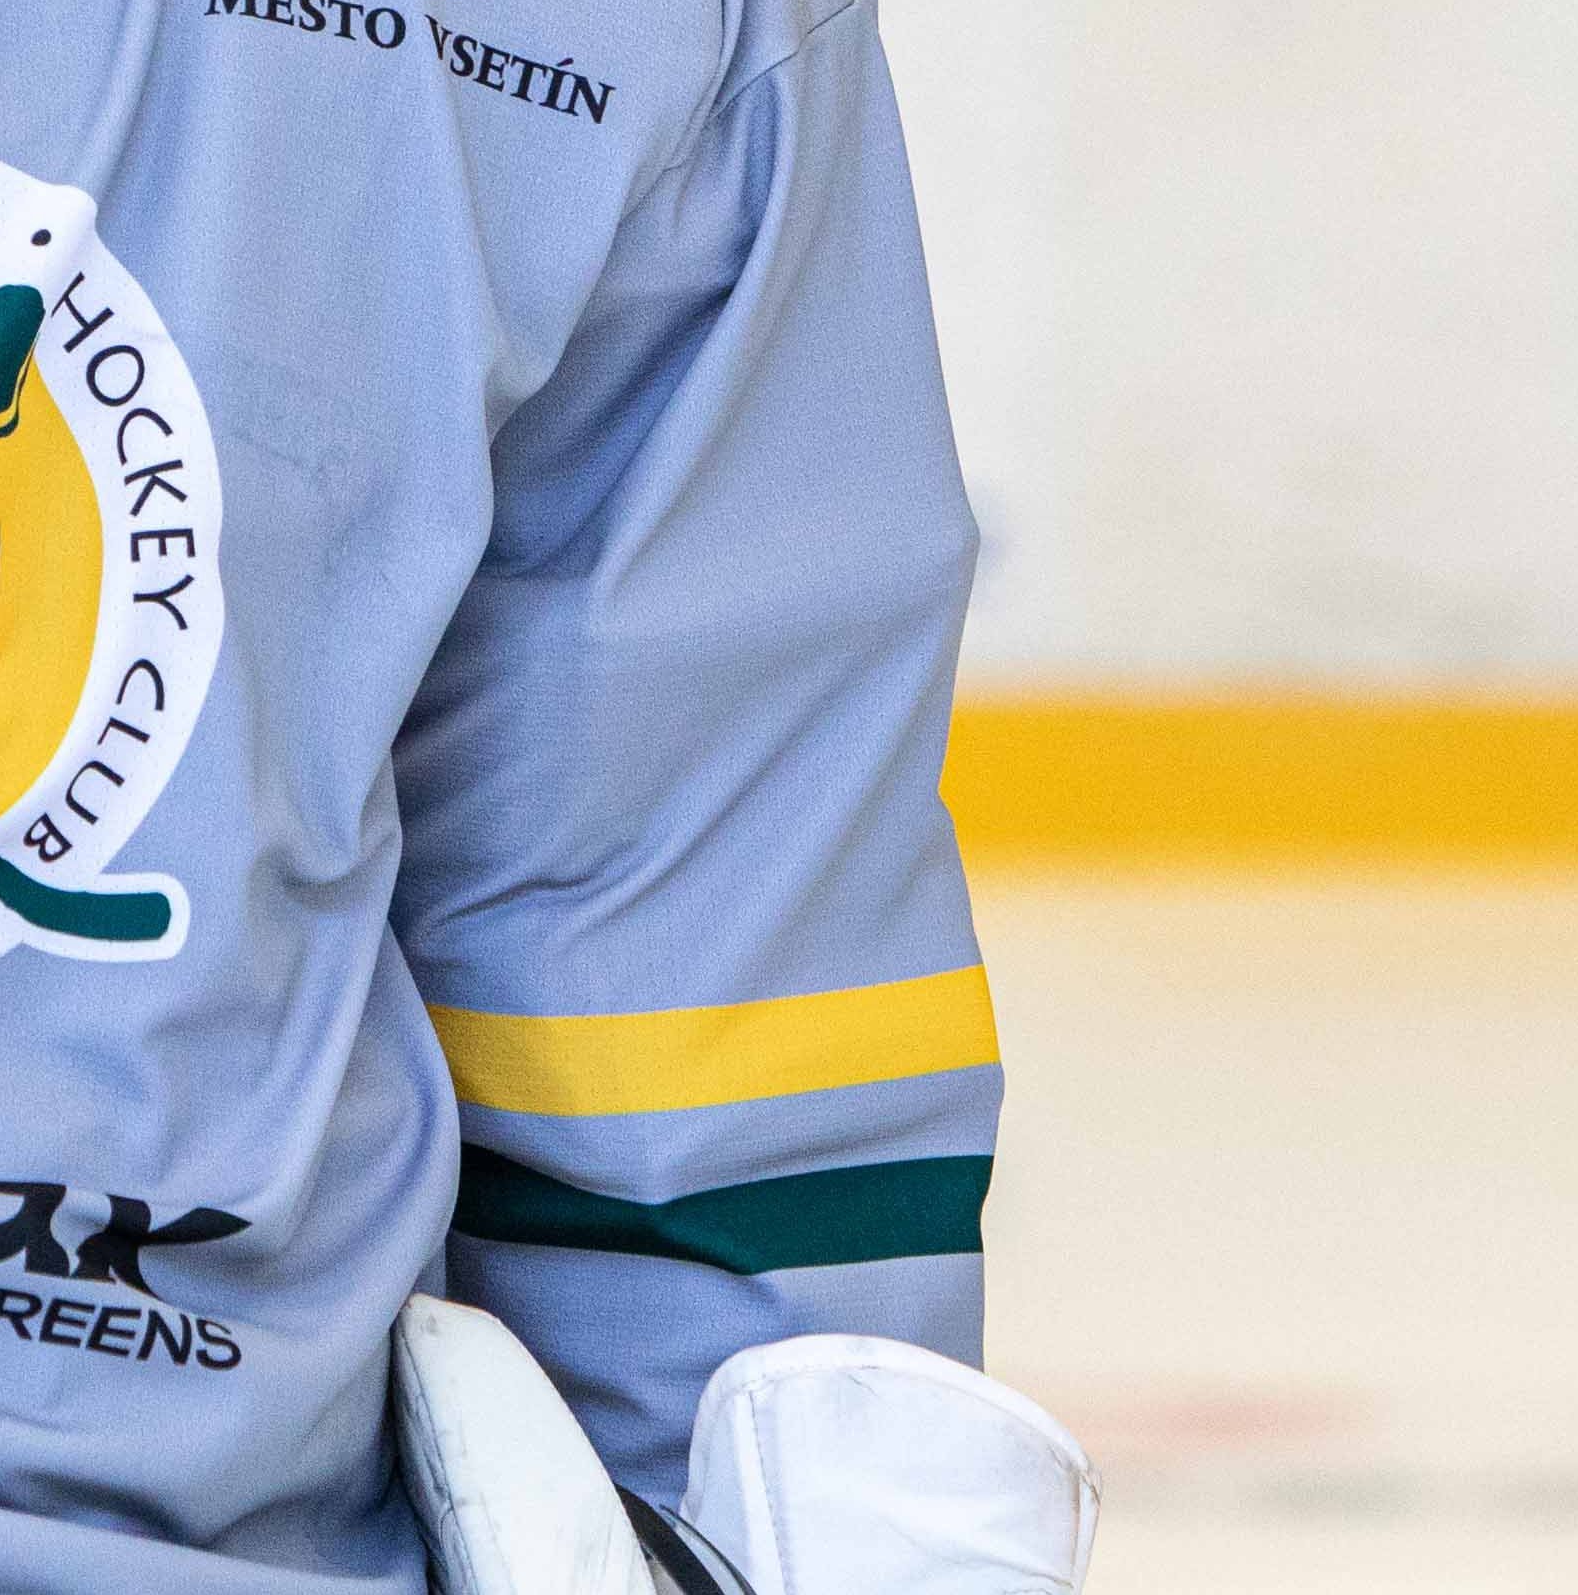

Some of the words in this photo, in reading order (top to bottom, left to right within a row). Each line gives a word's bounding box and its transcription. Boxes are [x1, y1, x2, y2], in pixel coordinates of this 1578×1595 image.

[424, 13, 616, 125] VSETÍN
[50, 270, 197, 631] HOCKEY
[22, 658, 166, 864] CLUB
